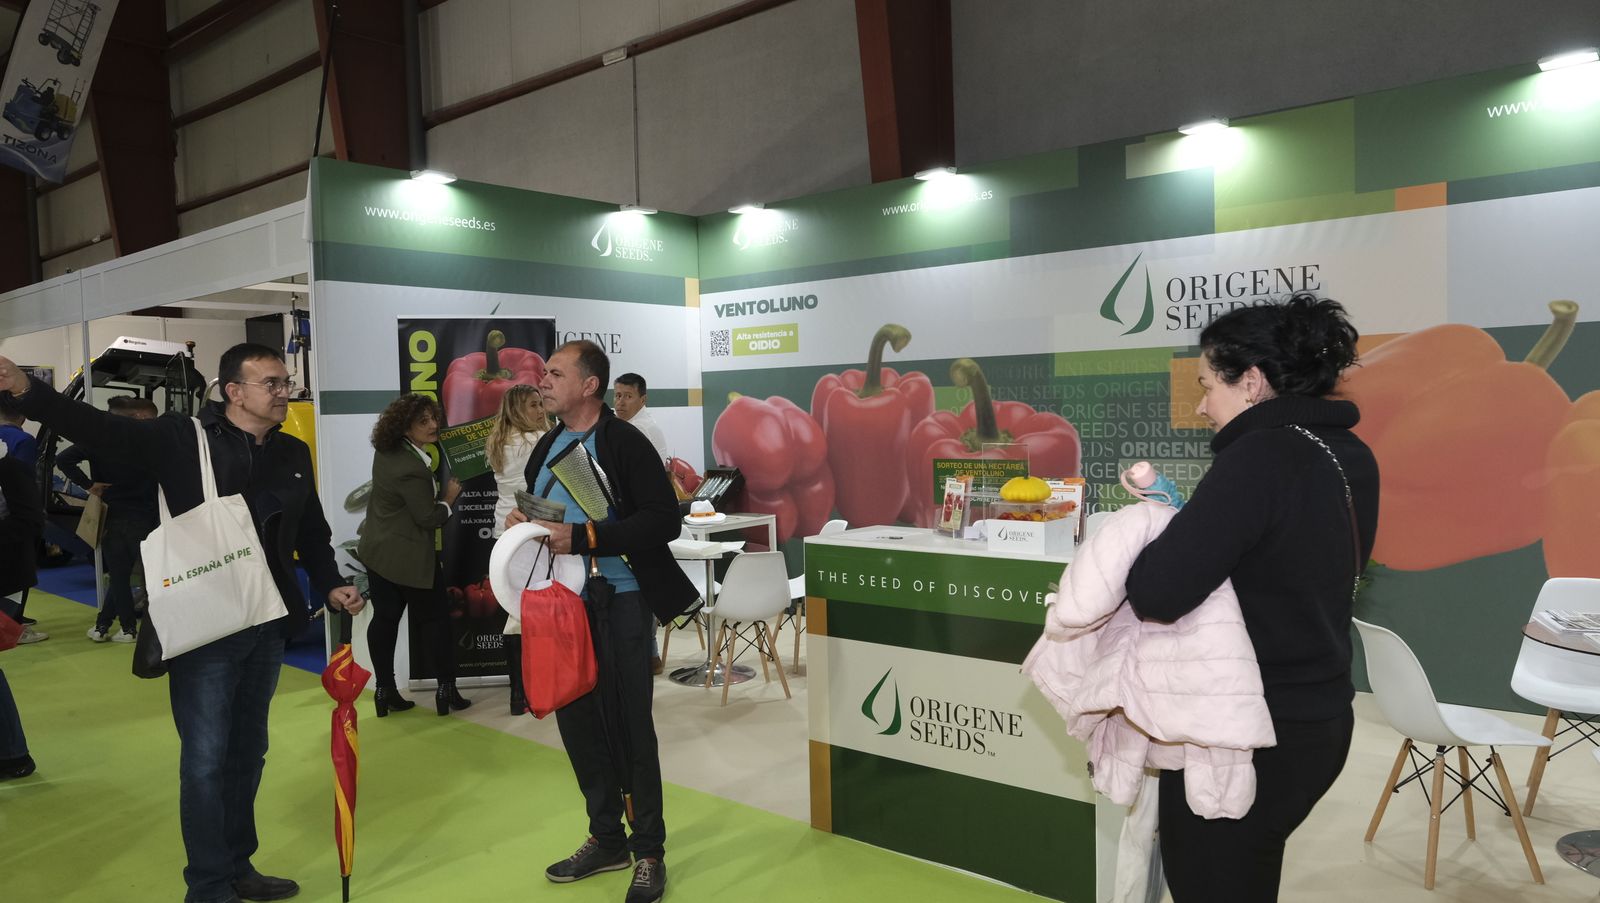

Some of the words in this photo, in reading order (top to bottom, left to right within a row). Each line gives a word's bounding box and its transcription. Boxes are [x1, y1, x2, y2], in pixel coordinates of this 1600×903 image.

[3, 133, 58, 165] TIZONA
[1165, 263, 1322, 303] ORIGENE
[713, 294, 819, 319] VENTOLUNO
[736, 332, 752, 341] Alta
[752, 330, 787, 341] resistencia
[788, 330, 795, 338] a
[1093, 379, 1185, 399] ORIGENE
[1060, 402, 1143, 420] ORIGENE
[439, 425, 472, 441] SORTEO
[472, 422, 485, 431] DE
[465, 431, 478, 442] DE
[1120, 440, 1213, 459] ORIGENE
[973, 462, 987, 470] UNA
[171, 574, 184, 585] LA
[186, 560, 223, 580] ESPAÑA
[223, 552, 236, 564] EN
[237, 546, 252, 559] PIE
[817, 570, 848, 584] THE
[858, 574, 901, 590] SEED
[913, 580, 936, 593] OF
[948, 583, 1043, 605] DISCOVE
[476, 633, 504, 643] ORIGE
[910, 695, 1024, 738] ORIGENE
[910, 719, 986, 755] SEEDS
